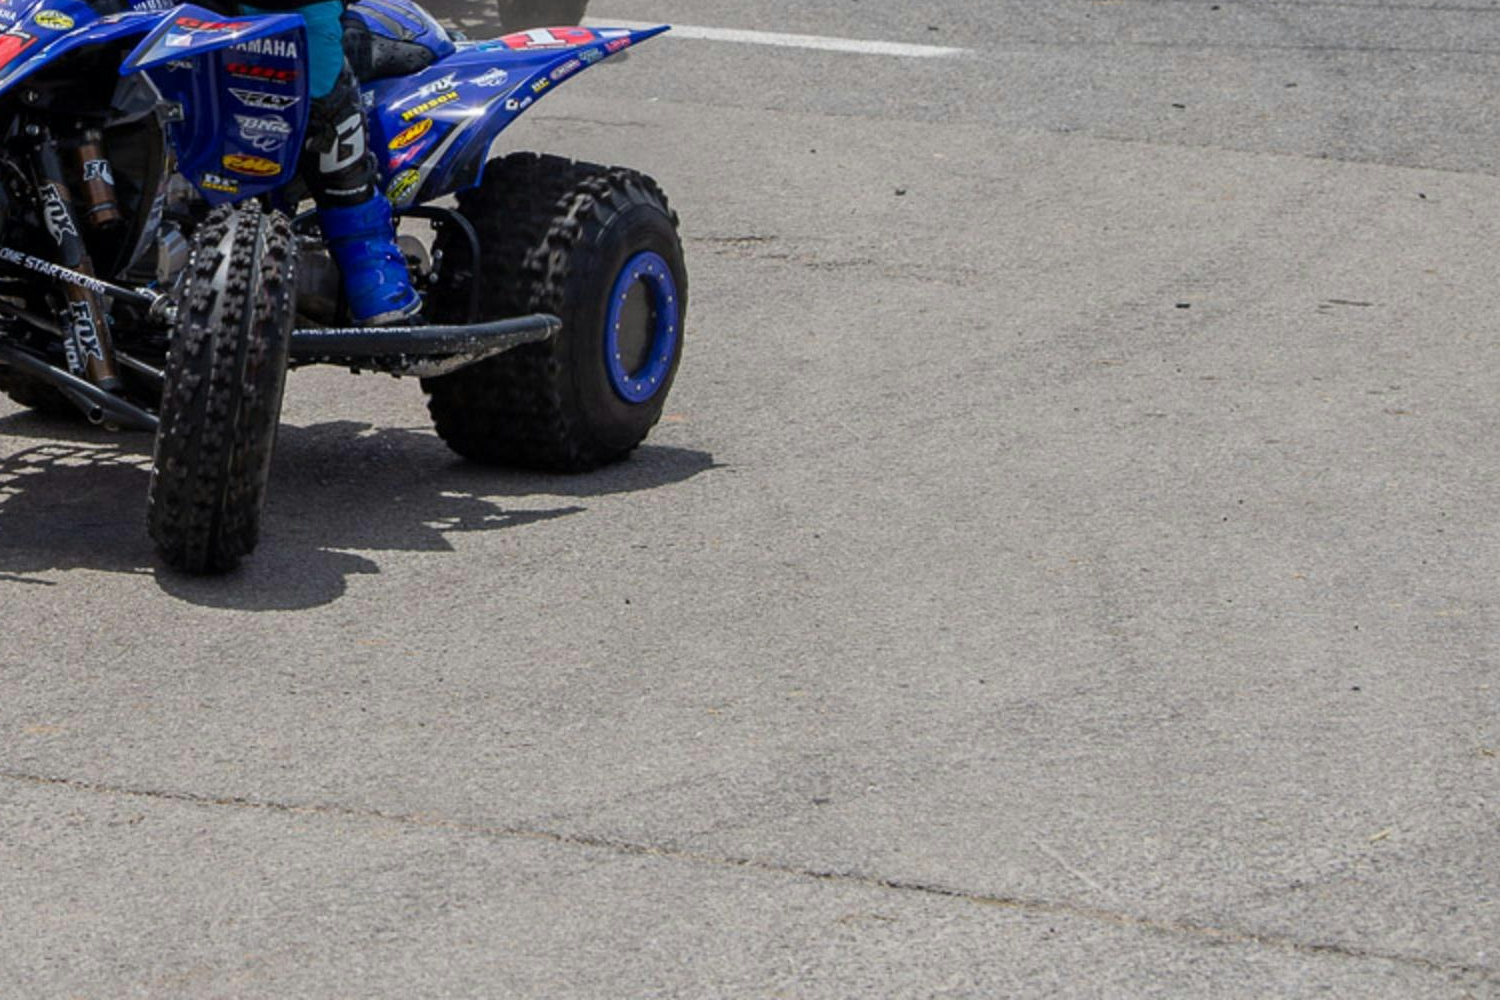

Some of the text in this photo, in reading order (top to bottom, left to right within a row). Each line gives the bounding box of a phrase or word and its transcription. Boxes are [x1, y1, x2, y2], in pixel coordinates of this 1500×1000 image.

[229, 38, 298, 59] AMAHA
[526, 29, 567, 46] 1
[401, 91, 458, 120] HINSON
[39, 183, 79, 246] FOX
[24, 255, 58, 277] STAR
[59, 267, 107, 294] RACING
[70, 301, 104, 371] FOX
